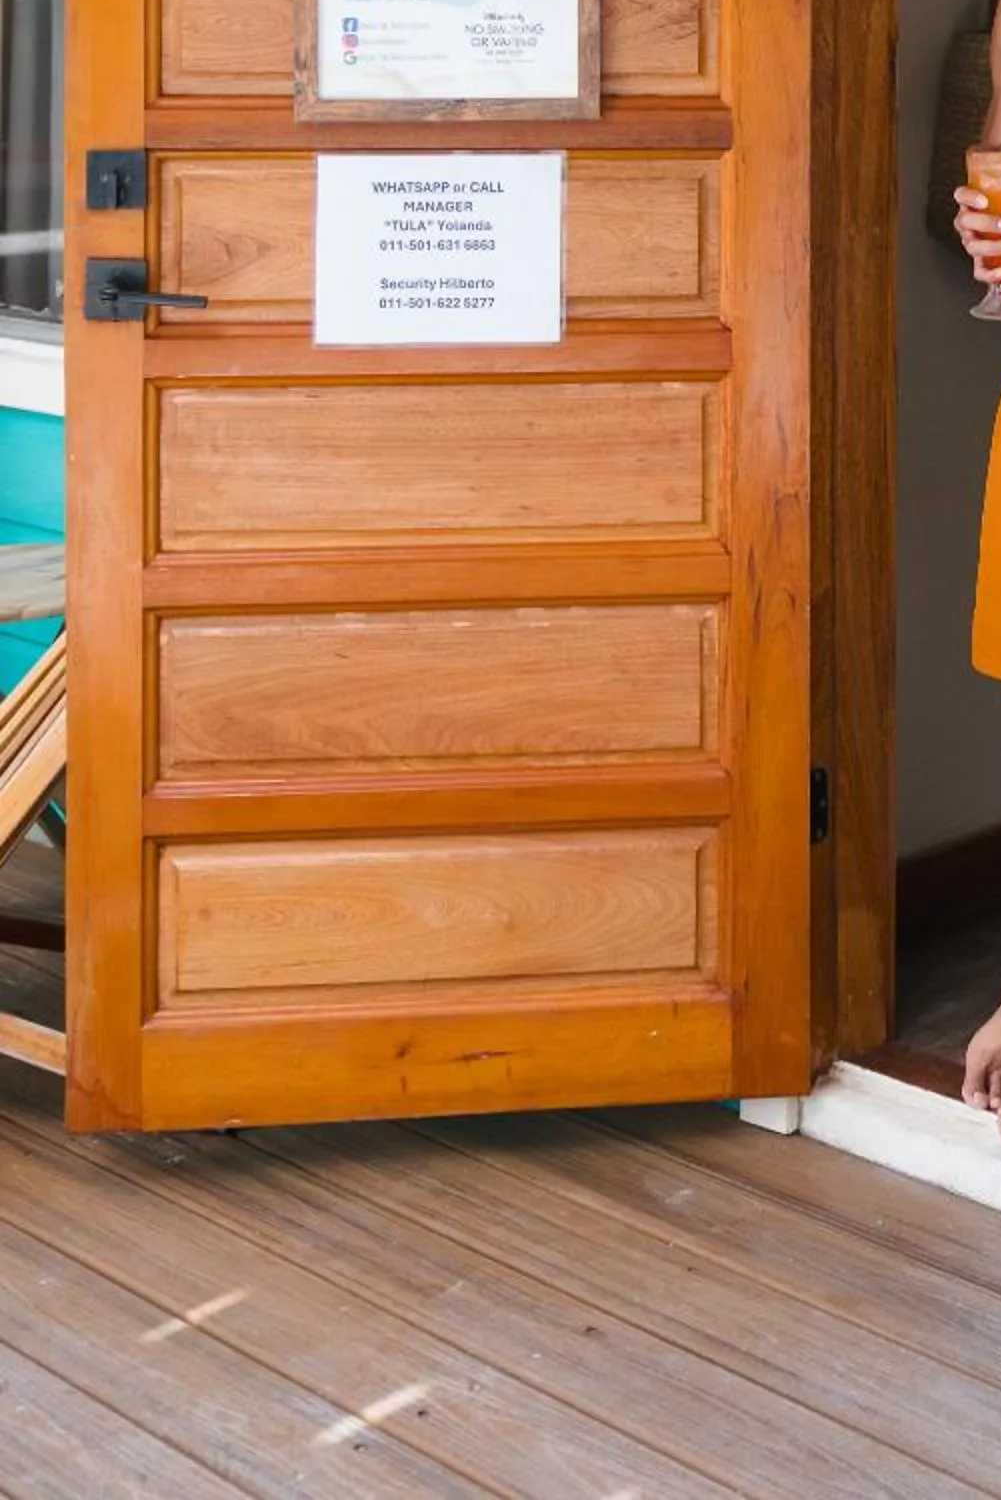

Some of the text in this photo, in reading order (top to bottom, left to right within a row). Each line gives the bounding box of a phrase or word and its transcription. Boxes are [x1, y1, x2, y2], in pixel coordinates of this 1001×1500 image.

[372, 181, 505, 194] WHATSAPP or CALL
[403, 201, 473, 213] MANAGER
[384, 219, 493, 232] "TULA" Yolanda
[379, 277, 495, 291] Security Hilberto
[379, 297, 461, 309] 011-501-622
